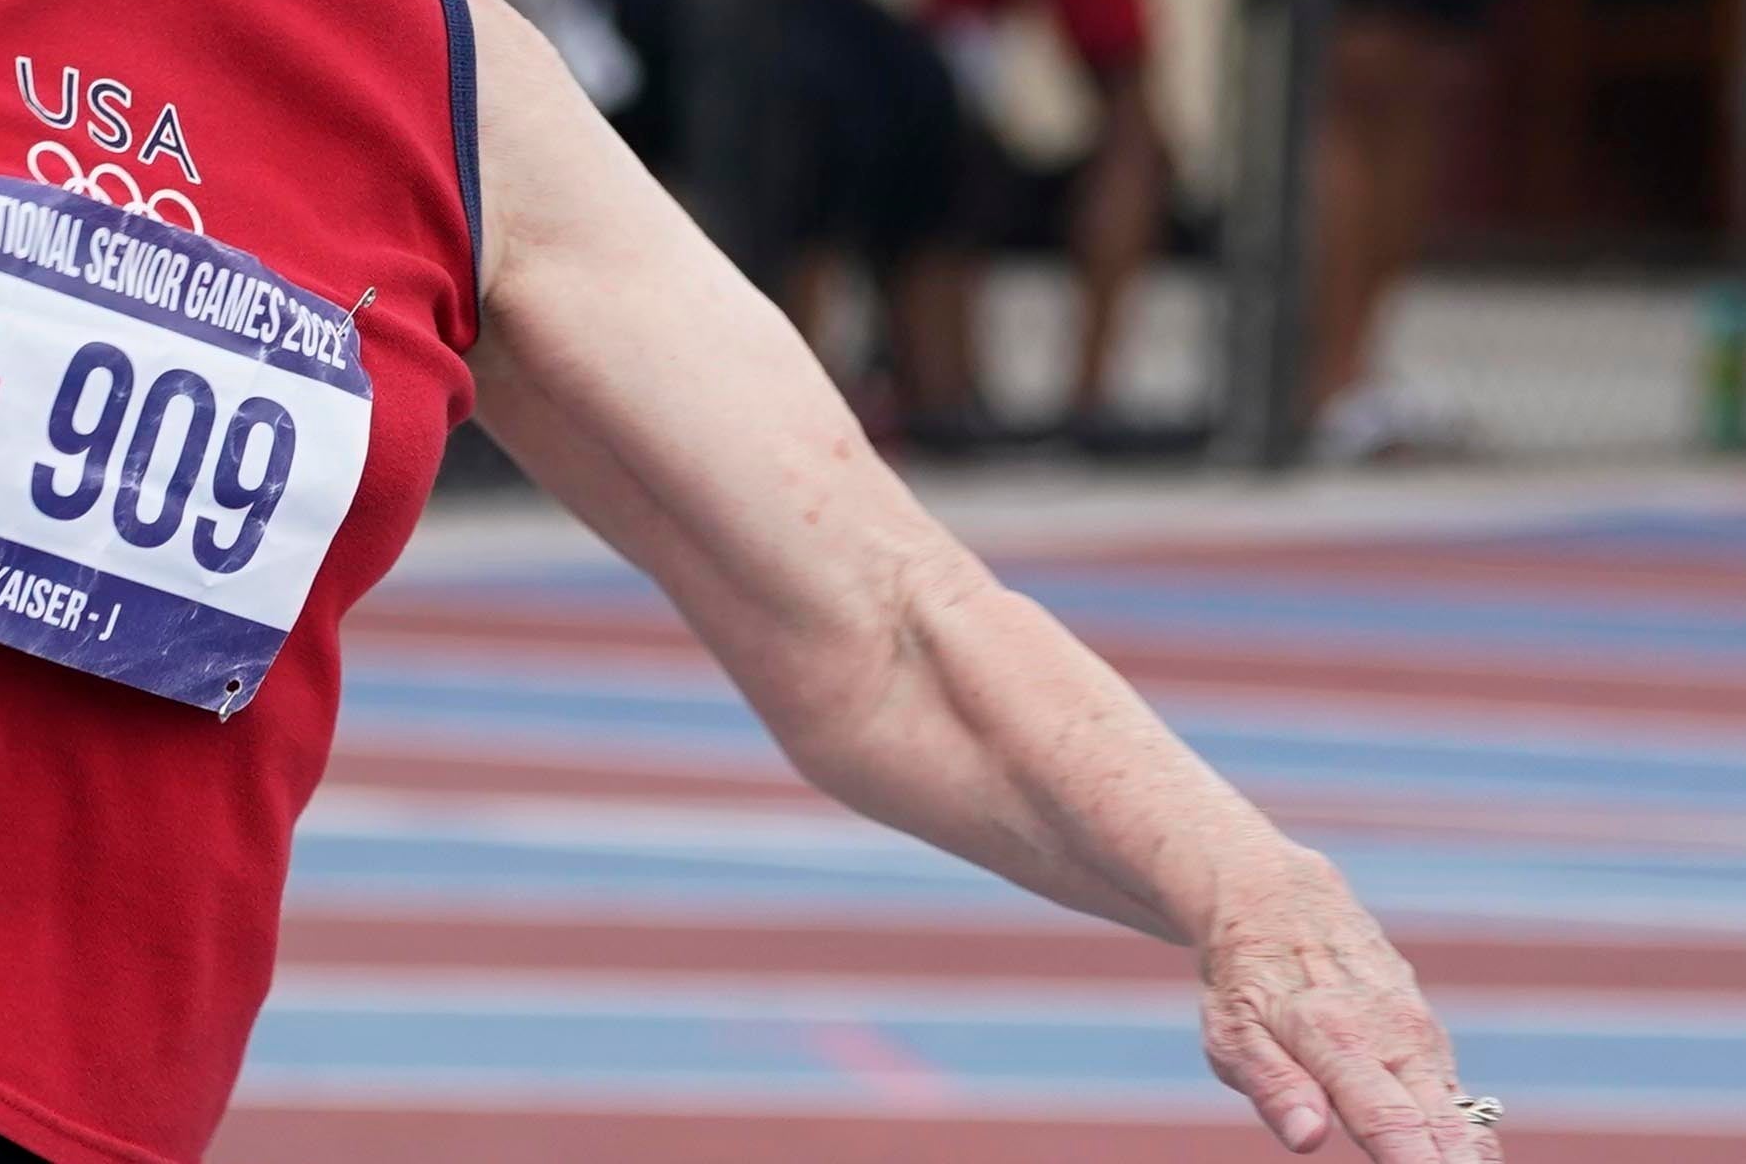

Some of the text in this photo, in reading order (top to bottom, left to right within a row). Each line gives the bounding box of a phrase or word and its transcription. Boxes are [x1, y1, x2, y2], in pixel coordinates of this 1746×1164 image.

[15, 56, 202, 184] USA
[84, 227, 189, 312] SENIOR
[184, 261, 286, 344] GAMES
[31, 342, 296, 574] 909
[98, 603, 122, 641] J
